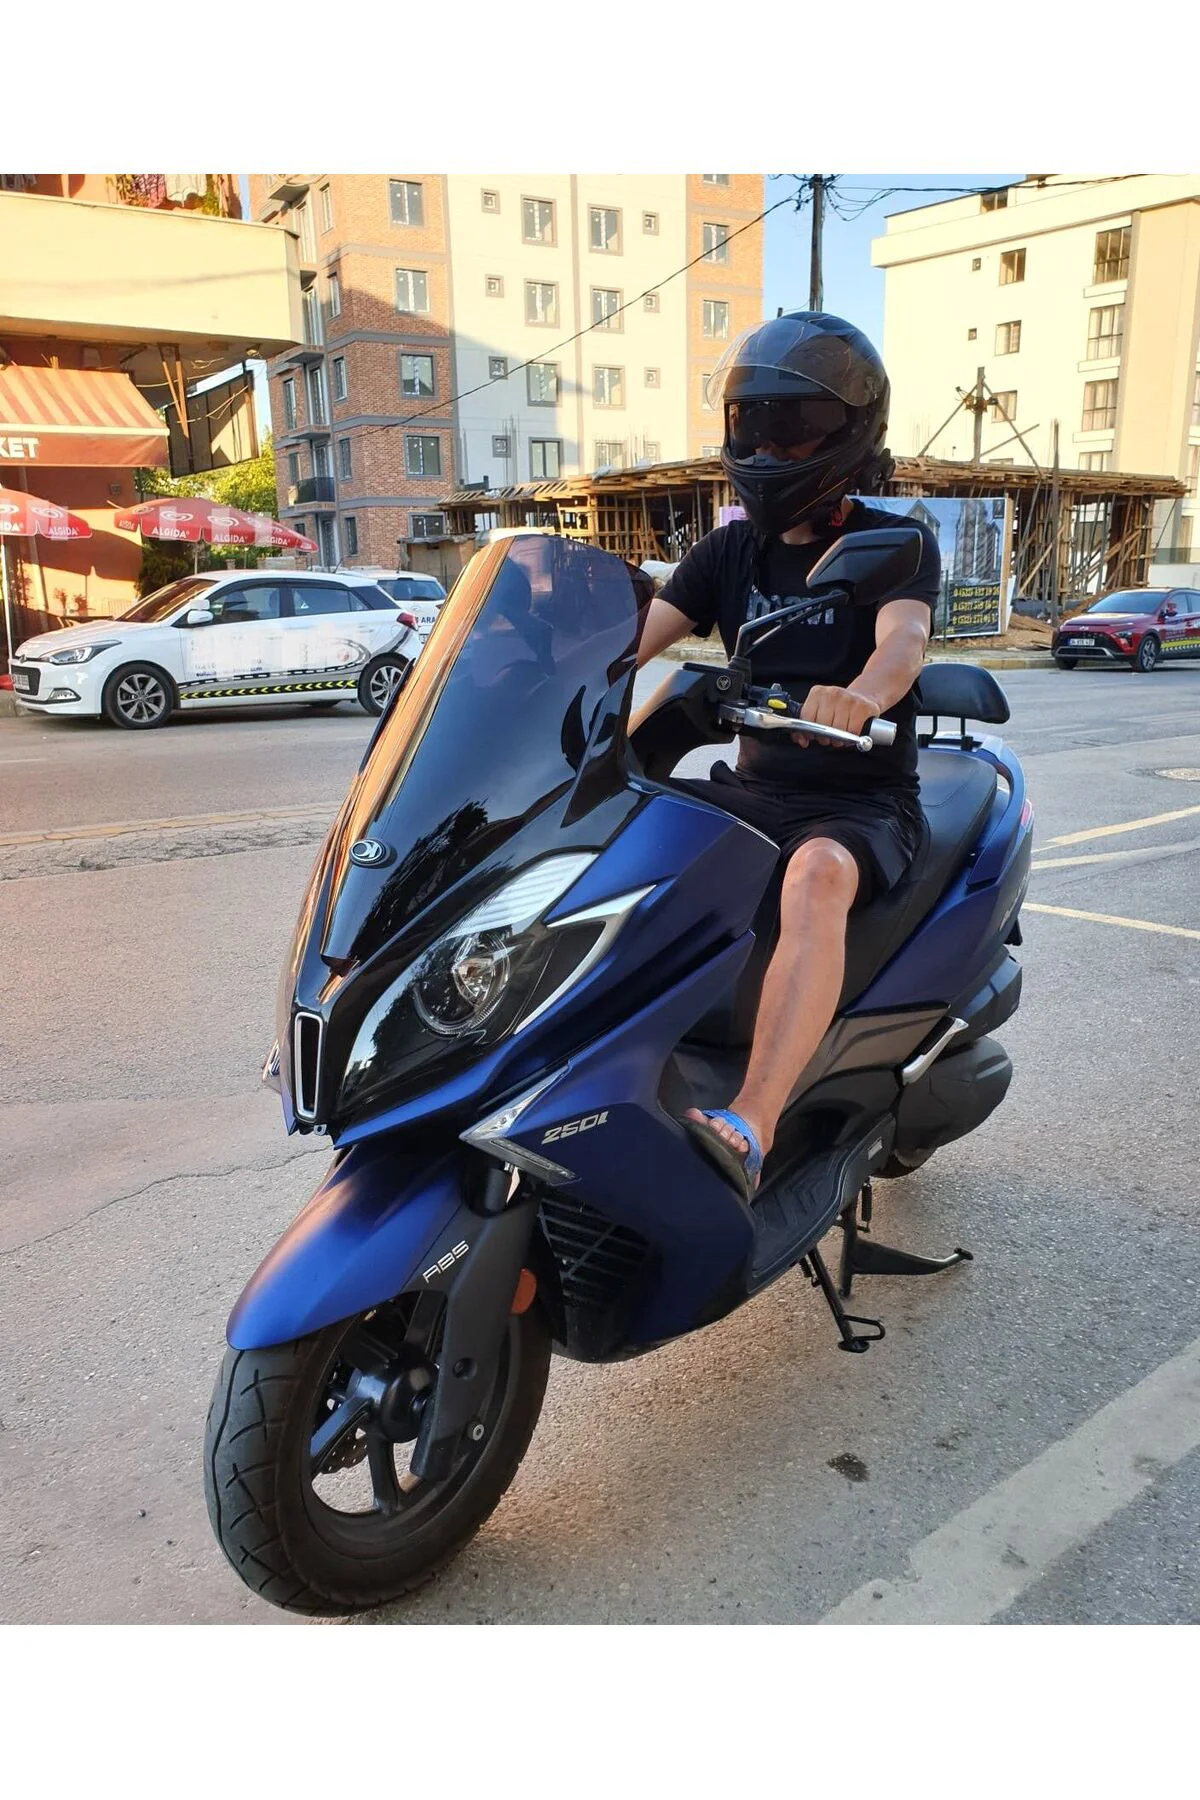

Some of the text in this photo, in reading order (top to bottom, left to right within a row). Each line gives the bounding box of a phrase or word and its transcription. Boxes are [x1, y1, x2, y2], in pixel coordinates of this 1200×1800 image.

[48, 526, 79, 536] ALGIDA
[151, 526, 187, 538] ALGIDA
[212, 533, 246, 543] ALGIDA
[422, 1240, 470, 1284] ABS
